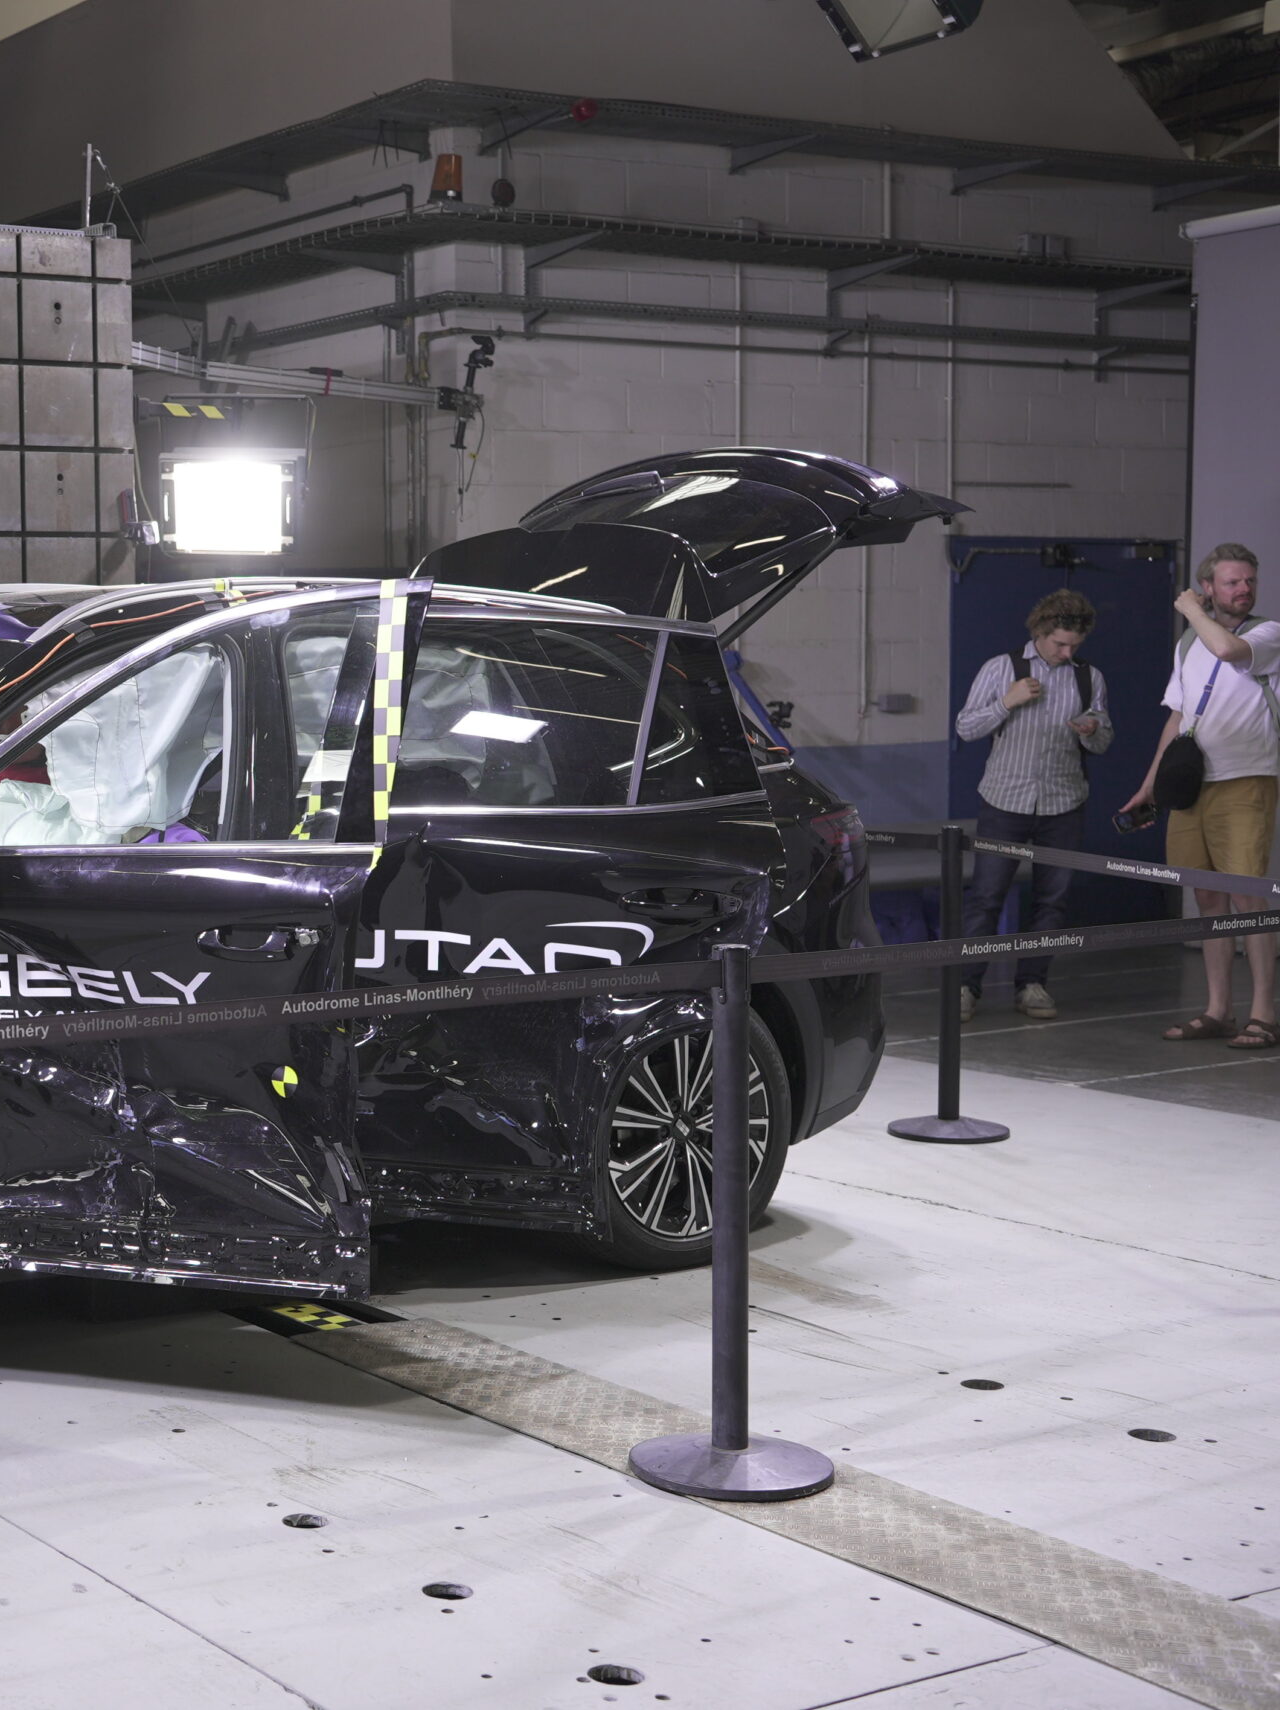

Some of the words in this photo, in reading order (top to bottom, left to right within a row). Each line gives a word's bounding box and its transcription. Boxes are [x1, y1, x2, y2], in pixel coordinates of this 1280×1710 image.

[1106, 861, 1136, 873] Autodrome
[1136, 865, 1181, 882] Linas-Montlhéry
[1212, 918, 1257, 931] Autodrome
[961, 941, 1012, 956] Autodrome
[1014, 934, 1085, 951] Linas-Montlhéry
[281, 995, 360, 1015] Autodrome
[364, 985, 474, 1007] Linas-Montlhéry
